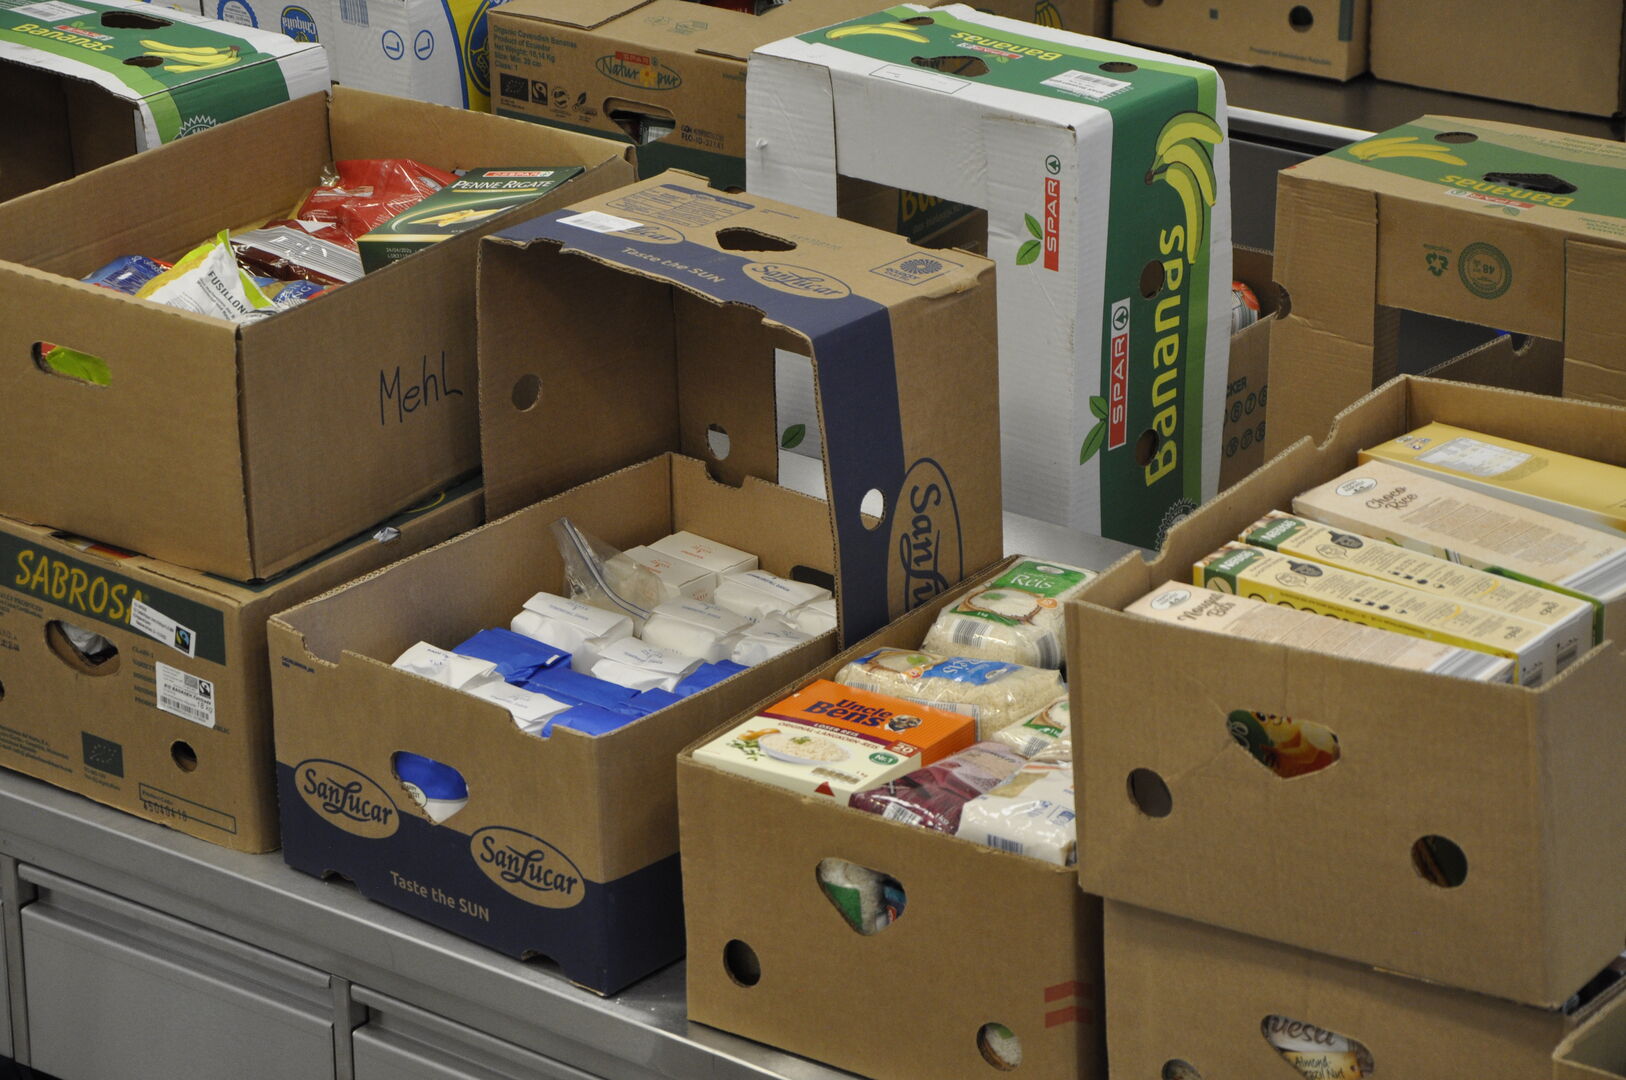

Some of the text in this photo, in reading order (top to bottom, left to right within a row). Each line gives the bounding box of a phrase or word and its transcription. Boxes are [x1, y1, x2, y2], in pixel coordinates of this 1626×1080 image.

[11, 24, 114, 51] Bananas
[951, 31, 1063, 62] Bananas
[602, 58, 678, 88] Natur pur
[622, 53, 650, 65] SPAR
[452, 179, 554, 190] PENNE RIGATE
[1440, 174, 1576, 208] Bananas
[1047, 179, 1058, 253] SPAR
[621, 247, 726, 284] Taste the SUN
[752, 265, 842, 296] SanLucar
[1145, 224, 1185, 488] Bananas
[1112, 336, 1126, 426] SPAR
[1365, 486, 1407, 510] Choco
[1384, 493, 1418, 511] Rice
[1010, 574, 1056, 589] Reis
[1177, 593, 1225, 622] Nougat
[834, 699, 893, 718] Uncle
[840, 729, 859, 737] REIS
[303, 767, 393, 826] SanLucar
[480, 836, 577, 896] SanLucar
[390, 871, 490, 923] Taste the SUN
